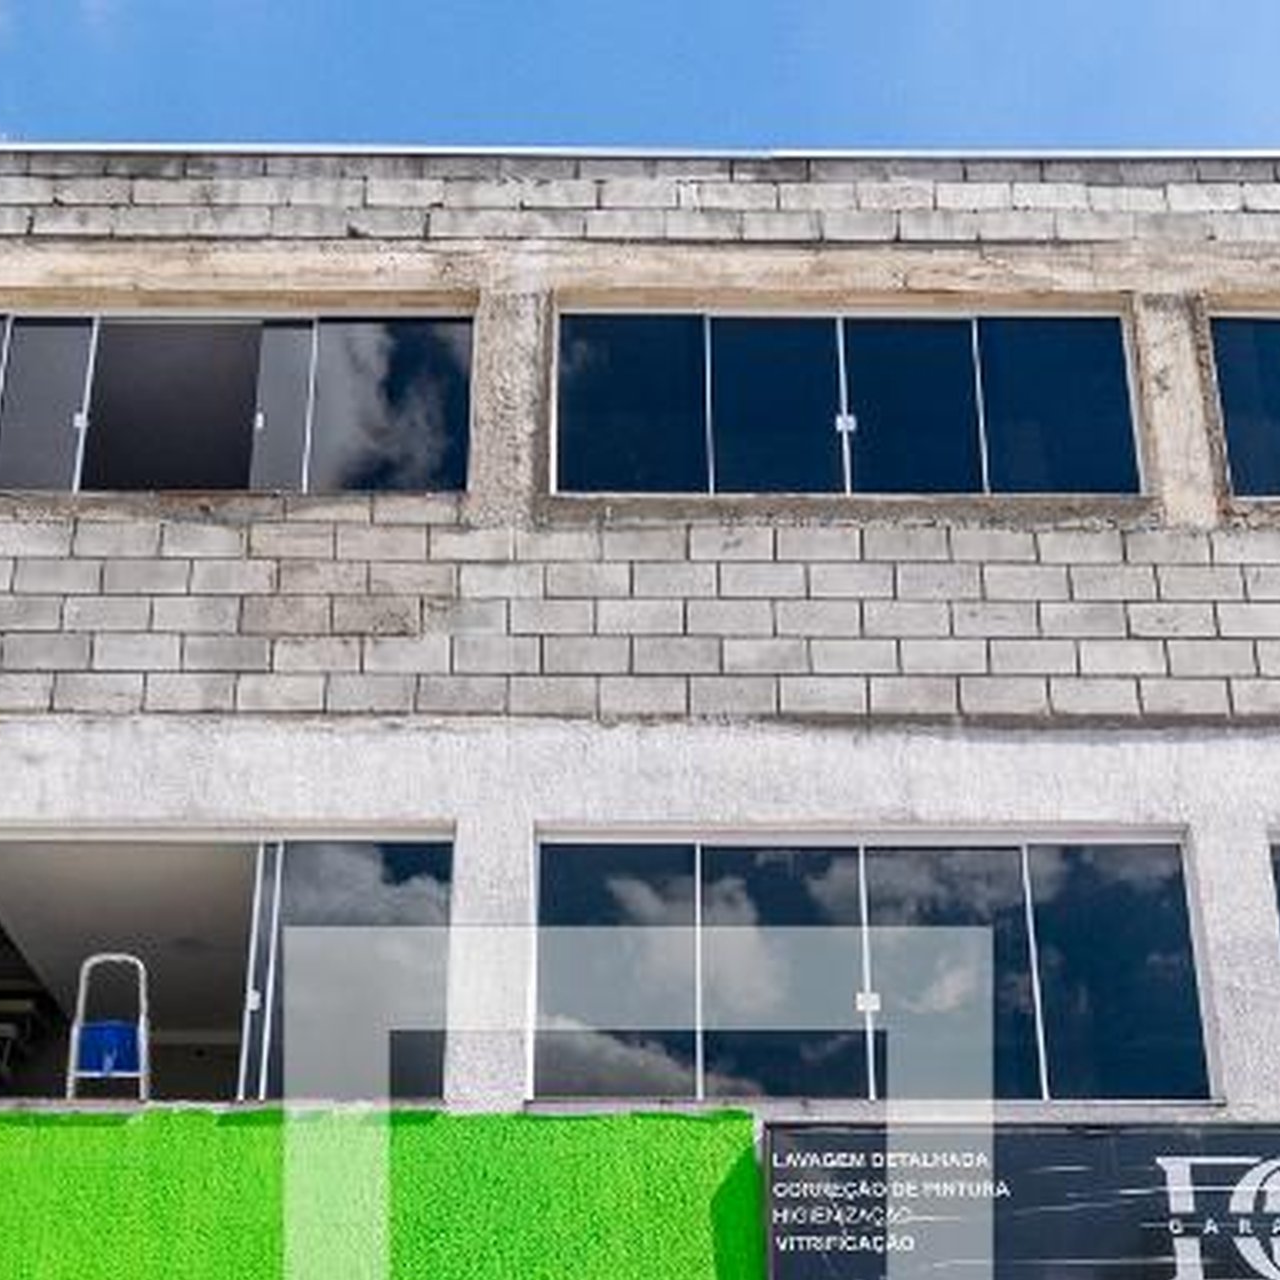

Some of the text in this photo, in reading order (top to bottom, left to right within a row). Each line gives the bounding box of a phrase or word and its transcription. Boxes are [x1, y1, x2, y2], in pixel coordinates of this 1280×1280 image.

[772, 1152, 988, 1168] LAVAGEM DETALHADA
[892, 1182, 919, 1197] DE
